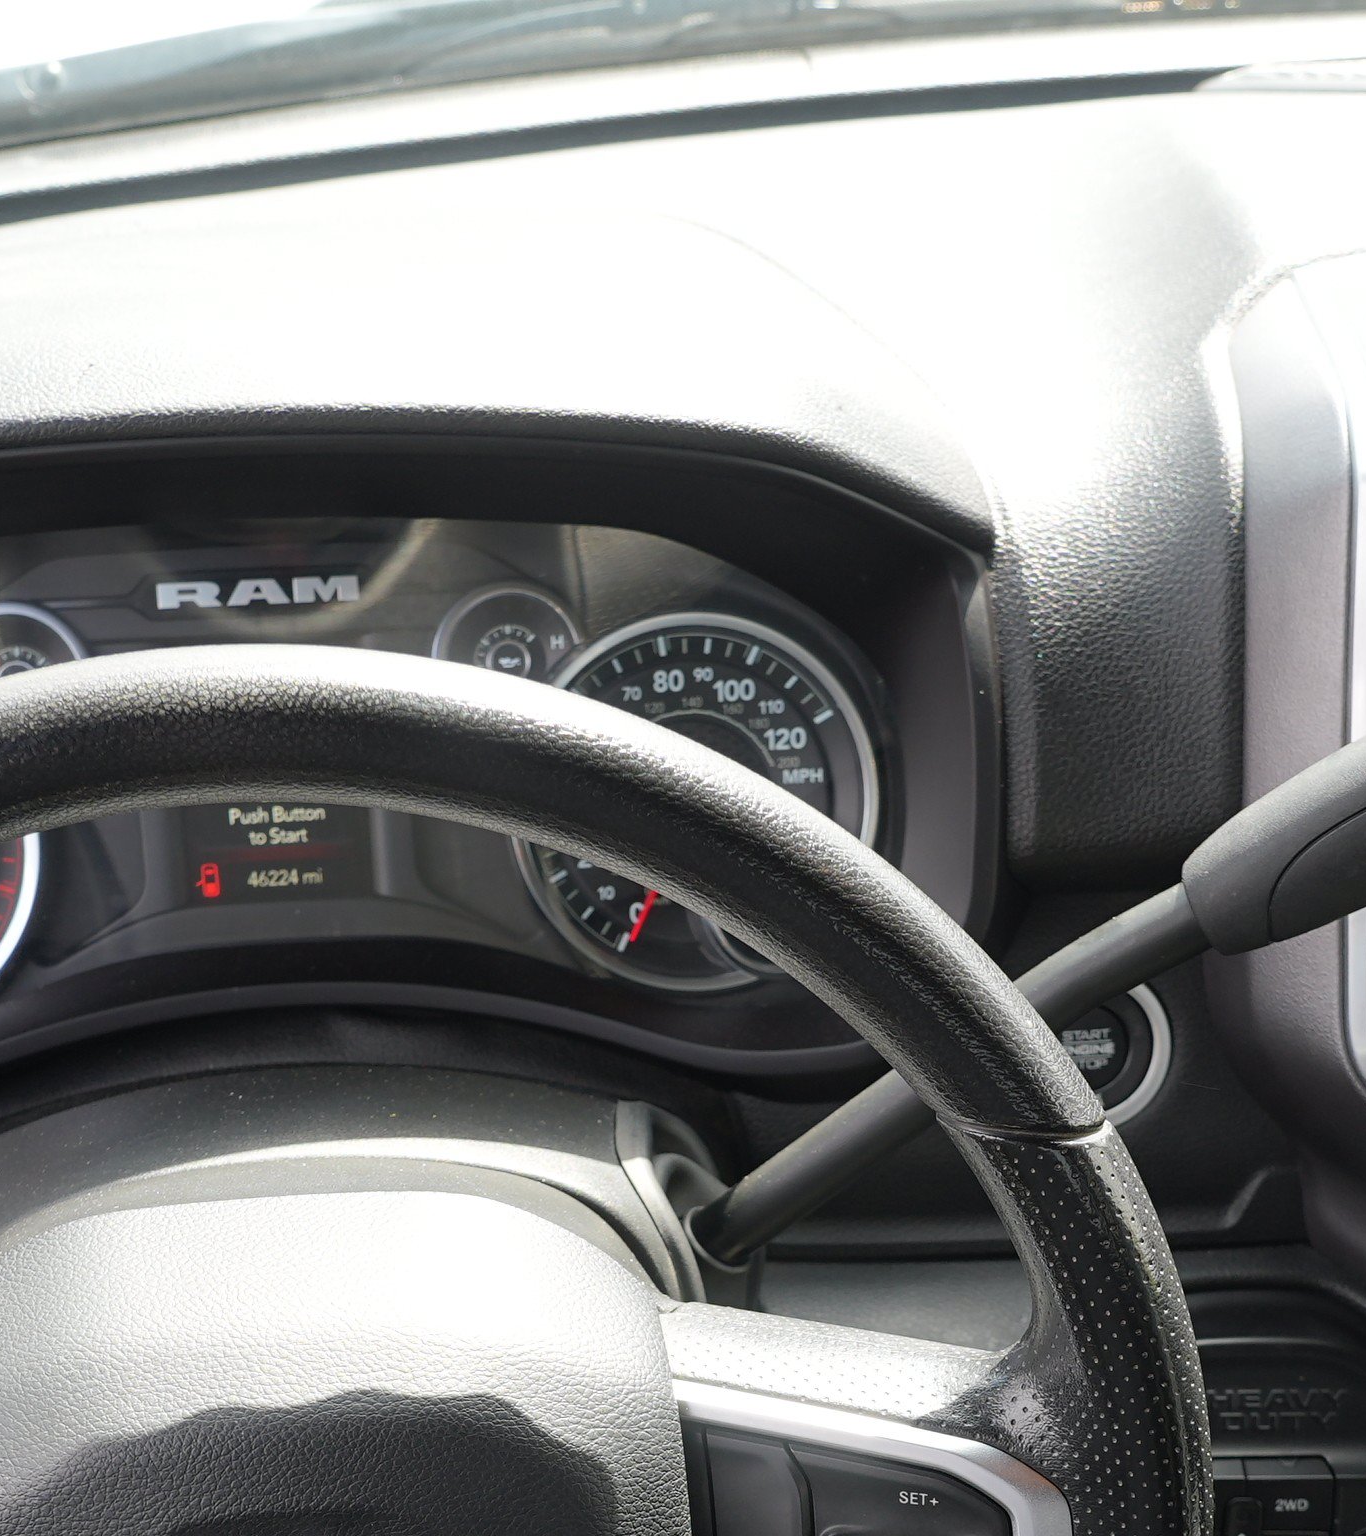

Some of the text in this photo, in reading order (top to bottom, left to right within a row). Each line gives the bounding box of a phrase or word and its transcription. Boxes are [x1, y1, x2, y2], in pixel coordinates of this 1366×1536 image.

[156, 575, 361, 610] RAM
[549, 634, 565, 651] H
[652, 668, 685, 694] 80
[692, 666, 714, 683] 90
[621, 686, 643, 702] 70
[712, 677, 756, 704] 100
[757, 699, 785, 715] 110
[763, 726, 808, 751] 120
[782, 766, 825, 784] MPH
[227, 804, 327, 826] Push Button
[248, 826, 309, 846] to Start
[246, 866, 324, 888] 46224 mi
[1062, 1028, 1112, 1041] START
[1063, 1042, 1116, 1055] NGINE
[1073, 1055, 1110, 1070] TOP
[1206, 1388, 1348, 1408] HEAVY
[1219, 1411, 1336, 1431] DUTY
[1274, 1498, 1310, 1513] 2WD
